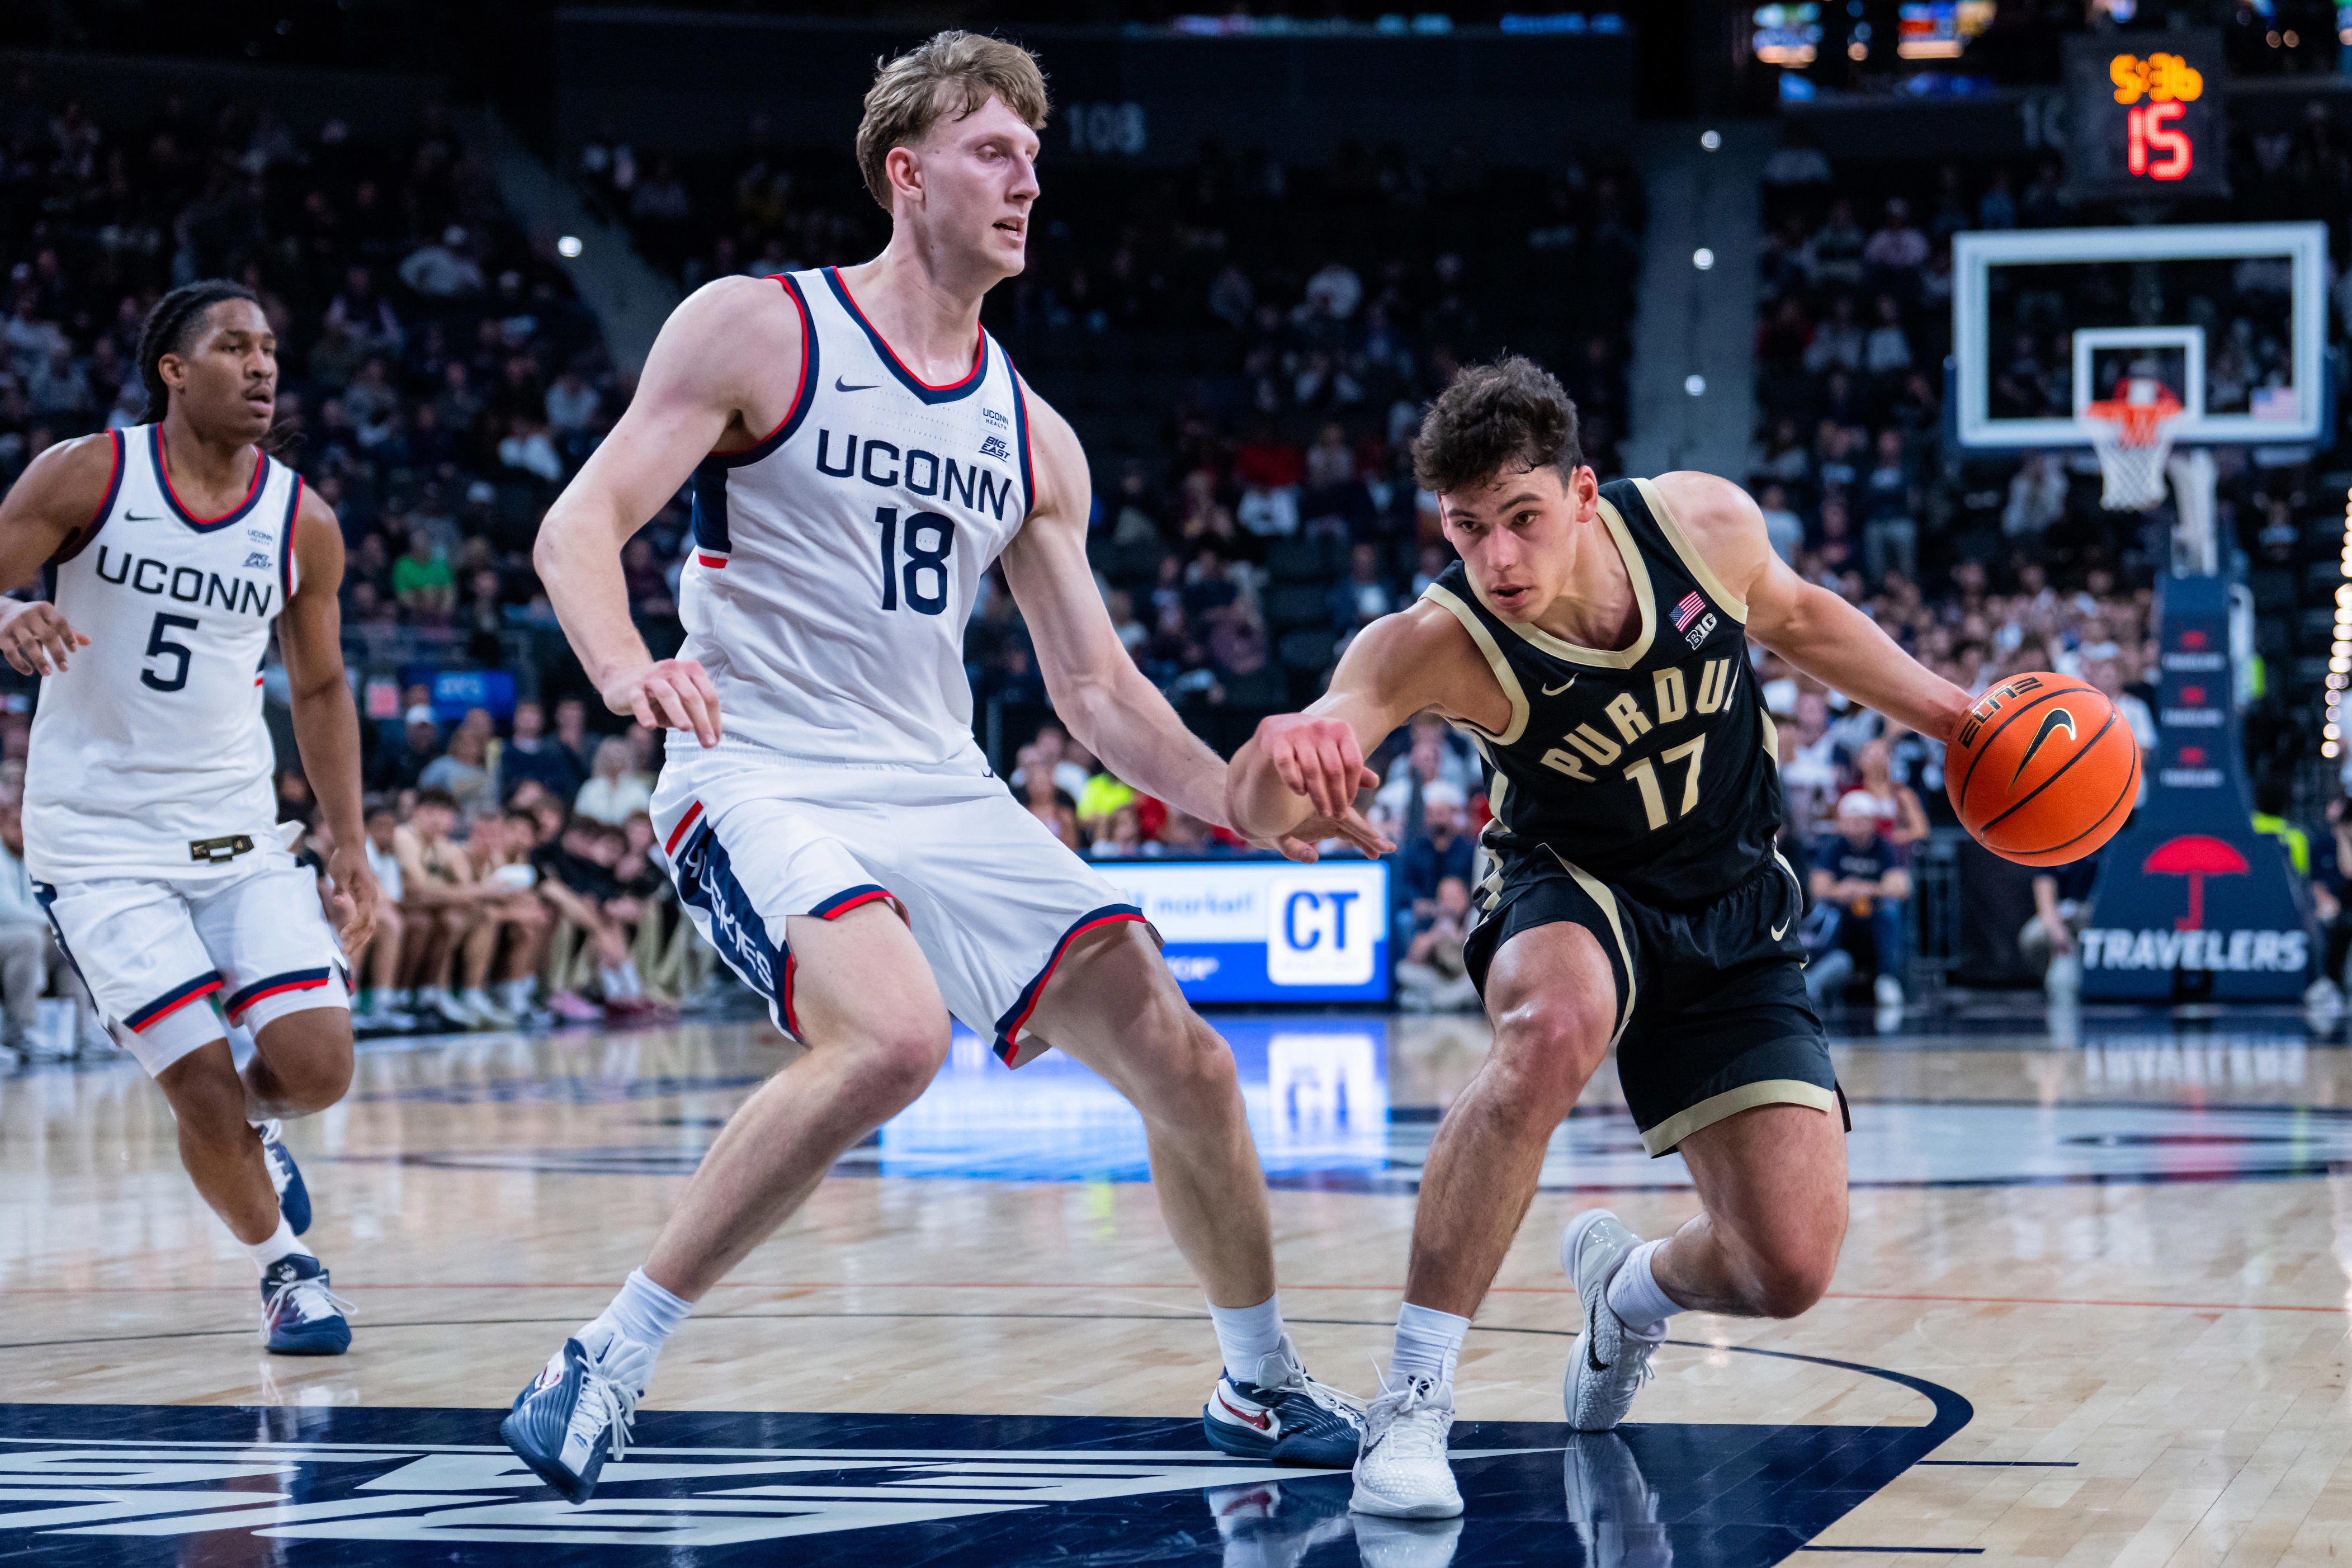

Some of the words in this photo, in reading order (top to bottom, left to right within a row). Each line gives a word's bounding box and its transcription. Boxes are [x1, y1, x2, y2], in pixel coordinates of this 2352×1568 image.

[2128, 100, 2192, 180] 15
[981, 443, 1010, 459] EAST
[983, 408, 1008, 425] UCONN
[985, 436, 1007, 449] BIG
[986, 419, 1007, 430] HEALTH
[816, 429, 1012, 521] UCONN
[247, 529, 272, 541] UCONN
[875, 507, 955, 615] 18
[96, 545, 272, 617] UCONN
[140, 611, 199, 692] 5
[1540, 651, 1743, 783] PURDU
[1958, 677, 2044, 749] ELITE
[1623, 732, 1706, 832] 17
[1283, 890, 1360, 952] CT
[2080, 929, 2307, 972] TRAVELERS
